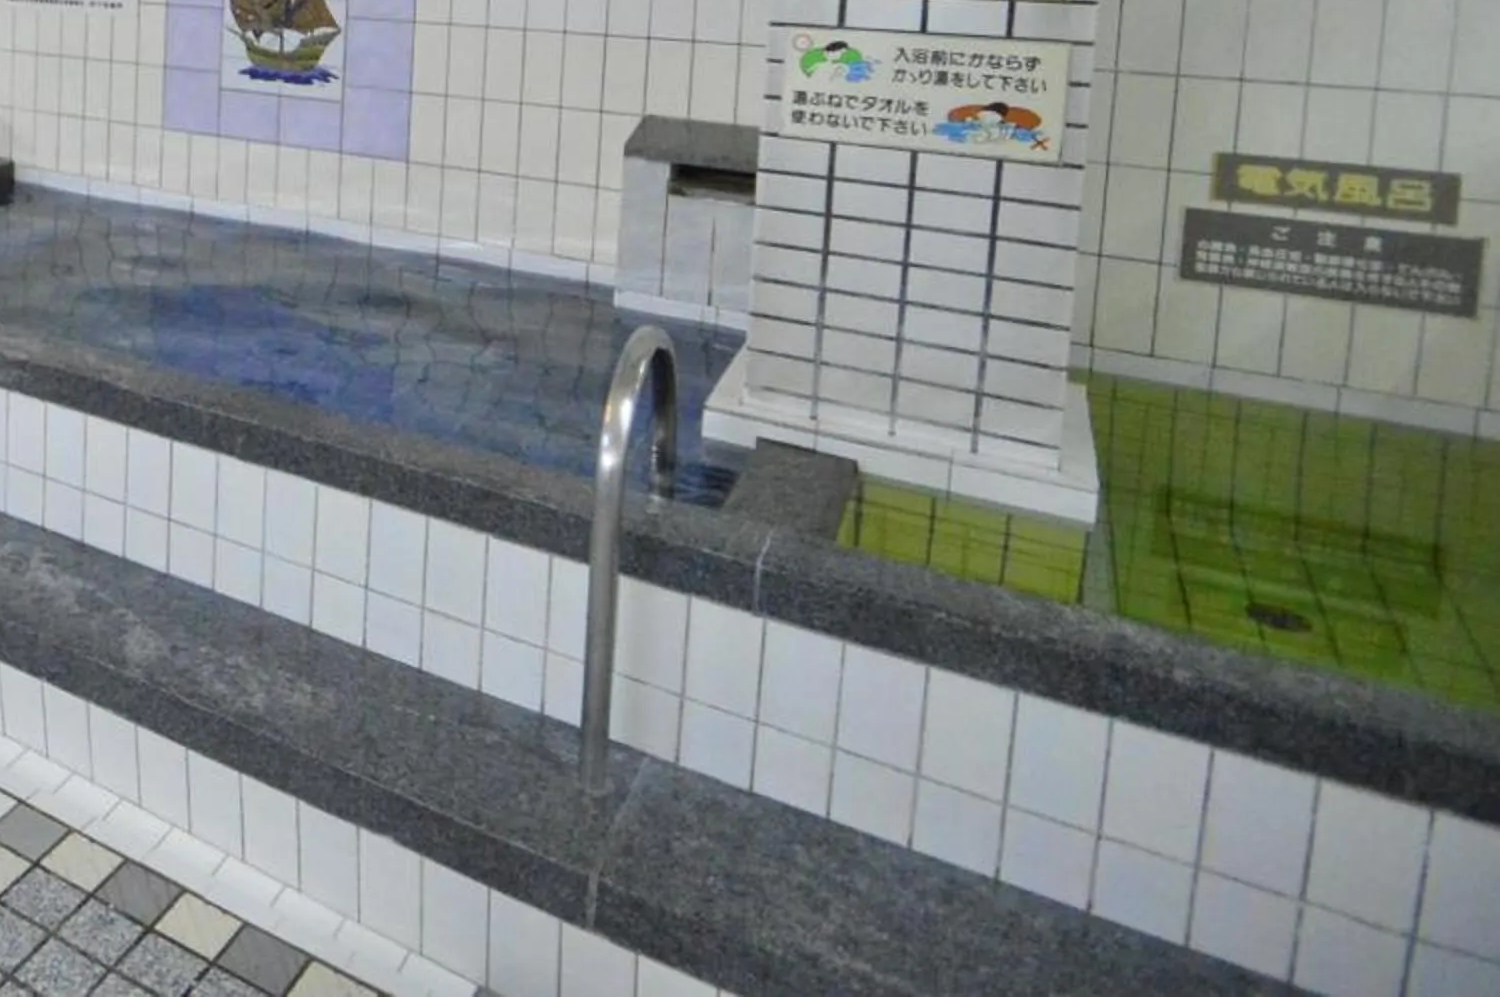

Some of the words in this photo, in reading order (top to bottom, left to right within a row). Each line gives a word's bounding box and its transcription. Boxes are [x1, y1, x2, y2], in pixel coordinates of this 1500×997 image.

[893, 47, 1041, 71] 入浴前にかならず
[792, 90, 930, 117] 湯ぶねでタオルを
[790, 109, 929, 137] 使わないで下さい
[1235, 164, 1432, 212] 電気風呂
